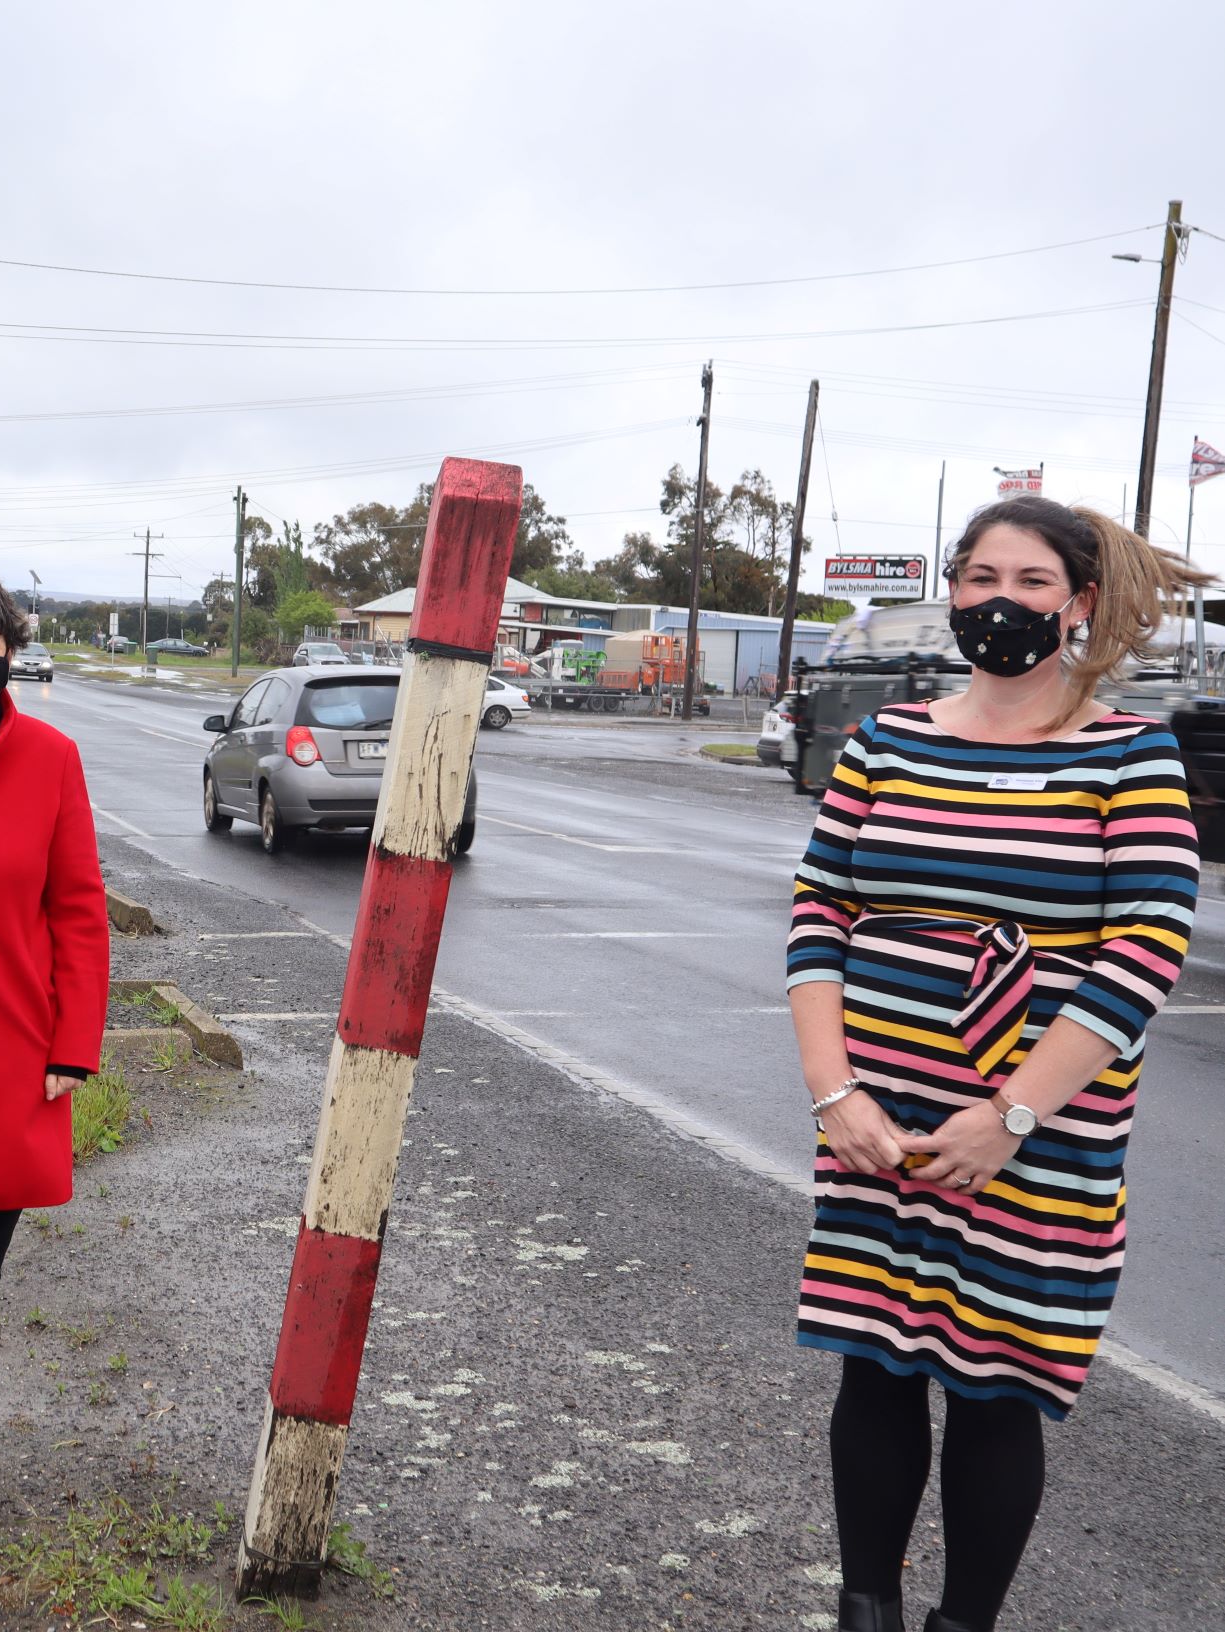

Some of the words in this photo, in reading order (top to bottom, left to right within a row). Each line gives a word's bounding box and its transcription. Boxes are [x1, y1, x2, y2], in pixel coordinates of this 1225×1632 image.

[828, 562, 872, 574] BYLSMA
[876, 562, 905, 576] hire
[828, 583, 919, 594] www.bylsmahire.com.au
